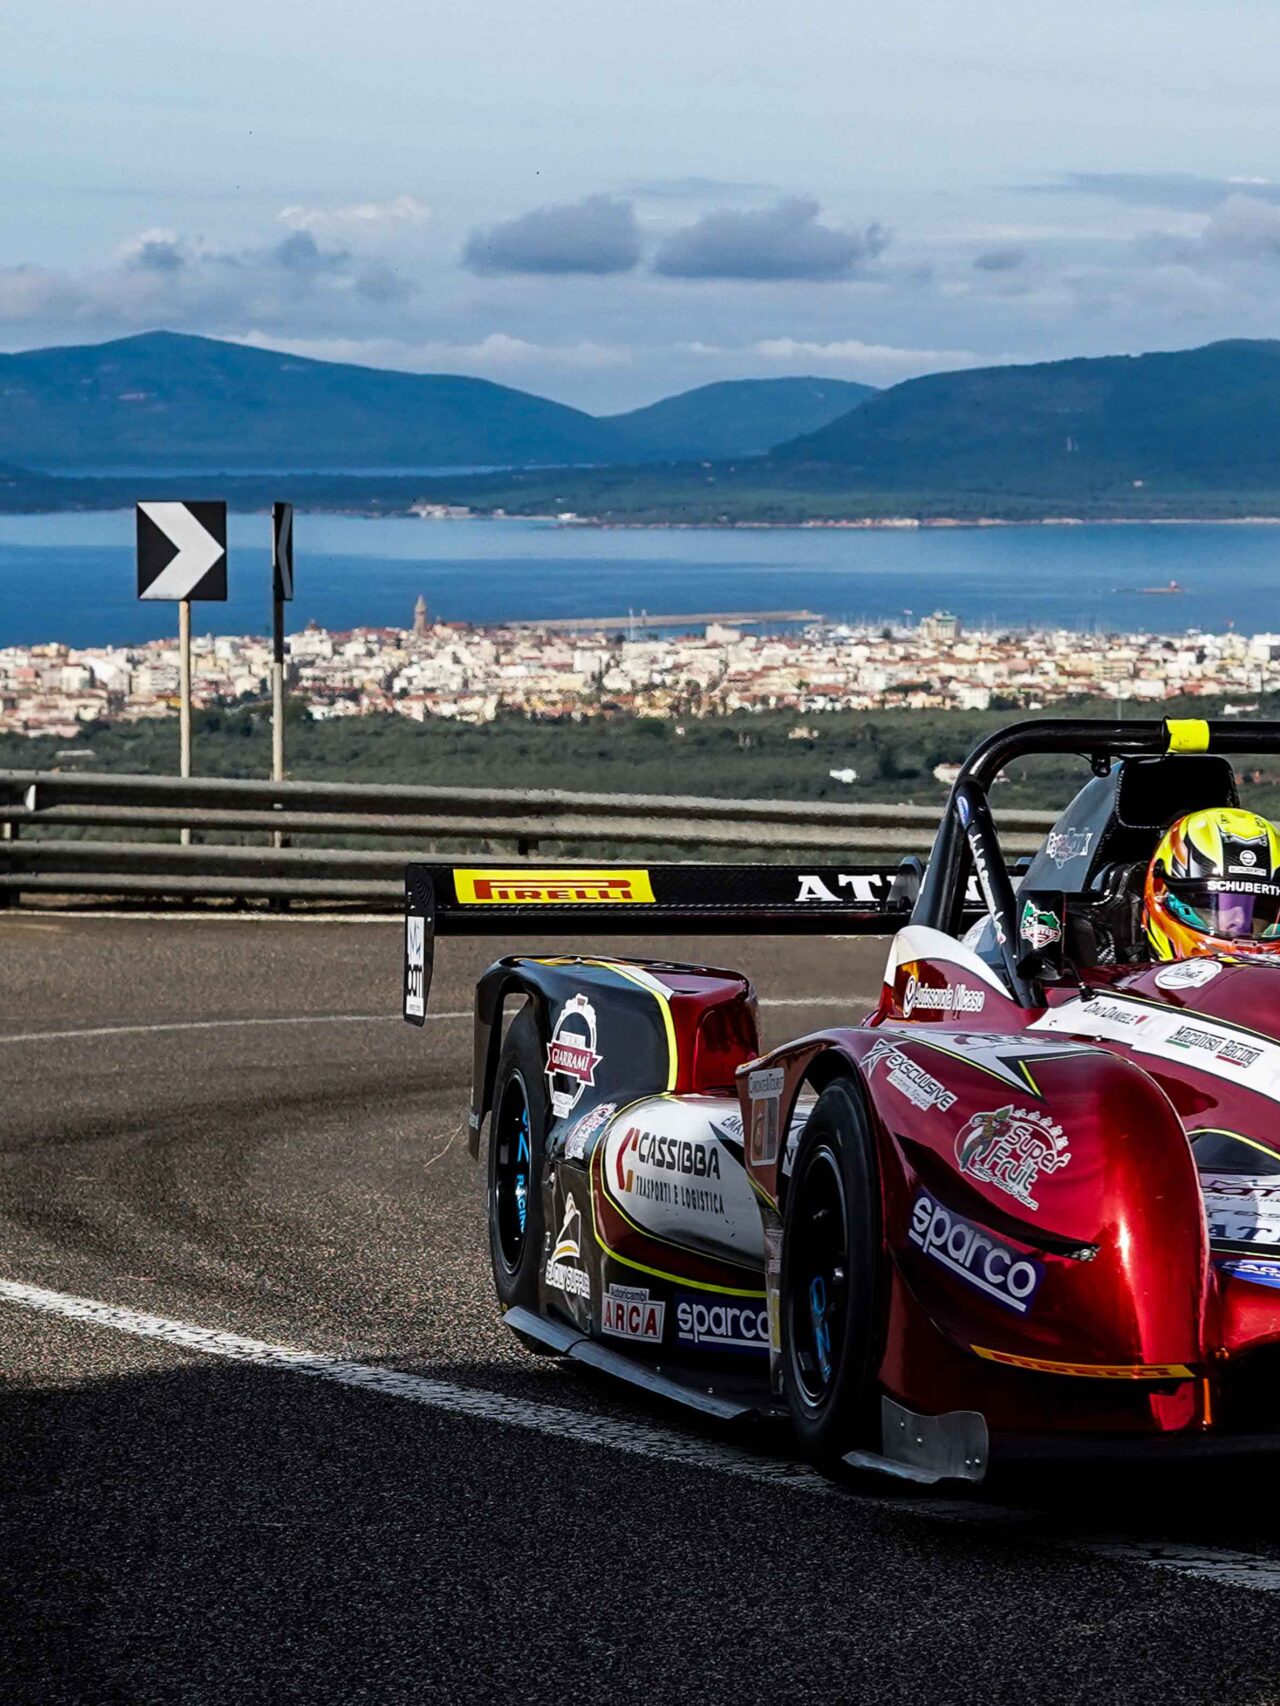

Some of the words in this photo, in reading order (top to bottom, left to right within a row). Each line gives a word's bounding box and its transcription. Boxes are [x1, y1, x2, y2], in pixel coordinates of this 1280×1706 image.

[473, 879, 633, 900] PIRELLI
[1217, 1039, 1264, 1068] Racing
[889, 1054, 954, 1108] EXSCLUSIVE
[638, 1132, 721, 1180] CASSIBBA
[985, 1146, 1037, 1192] Fruit
[1005, 1125, 1071, 1173] Super
[635, 1175, 671, 1204] TRASPORTI
[674, 1184, 678, 1205] E
[682, 1188, 725, 1214] LOGISTICA
[912, 1196, 1036, 1299] sparco
[604, 1301, 658, 1336] ARCA
